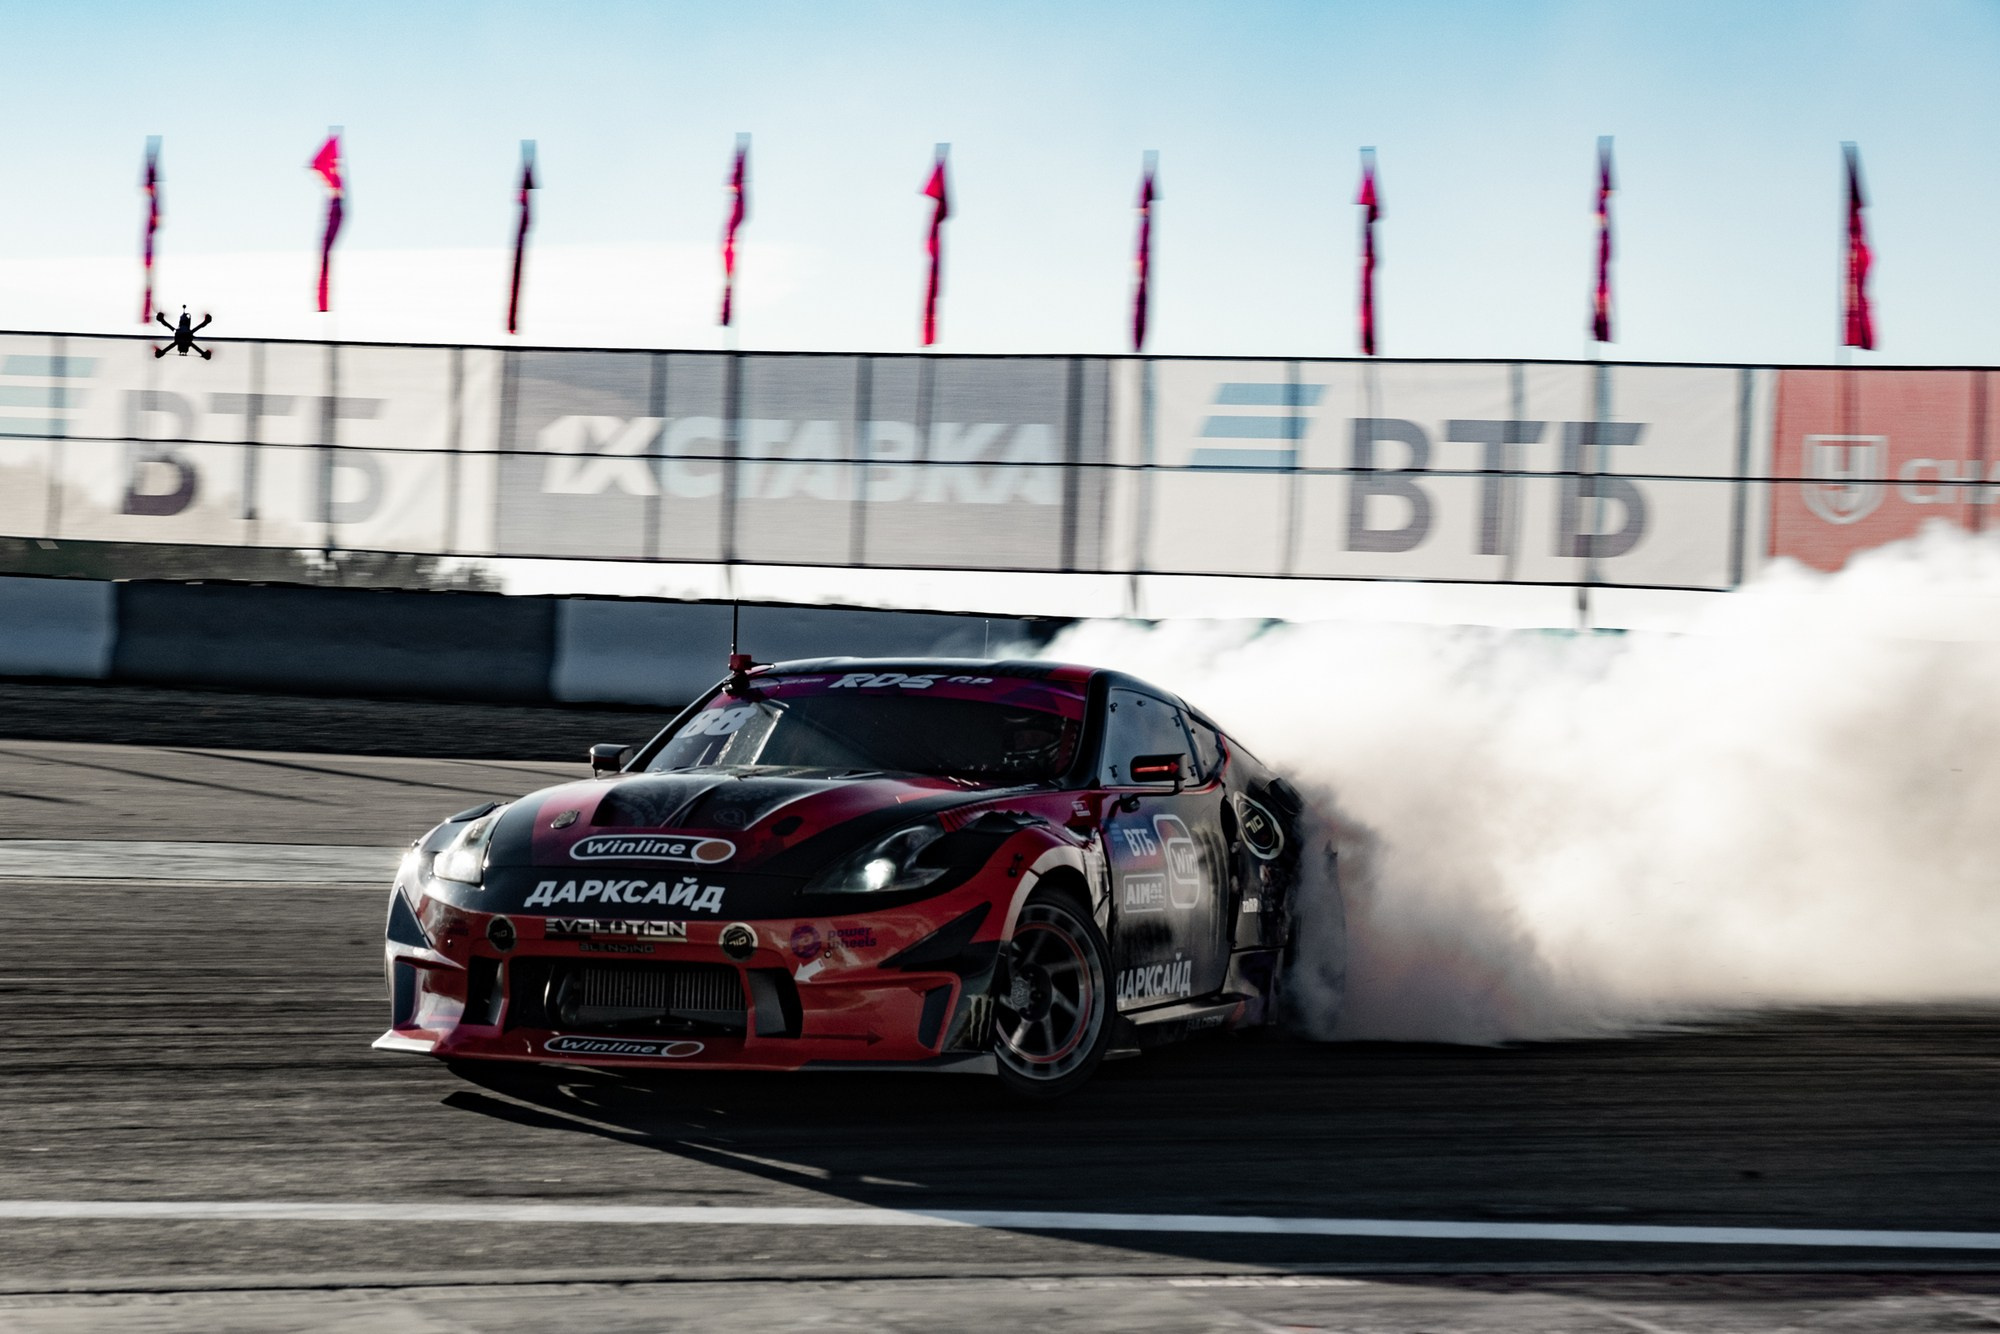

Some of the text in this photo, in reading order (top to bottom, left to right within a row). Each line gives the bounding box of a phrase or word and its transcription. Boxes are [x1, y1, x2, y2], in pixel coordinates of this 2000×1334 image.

[1341, 417, 1650, 558] ВТБ
[827, 673, 949, 689] RDS
[675, 706, 757, 738] 88
[586, 839, 686, 855] Winline
[1123, 828, 1157, 856] ВТБ
[523, 877, 725, 913] ДАРКСАЙД
[1125, 883, 1164, 905] AIMOL
[545, 918, 687, 936] EVOLUTION
[828, 927, 872, 941] power
[580, 943, 656, 953] BLENDING
[1117, 952, 1191, 1007] ДАРКСАЙД
[560, 1038, 657, 1053] Winline
